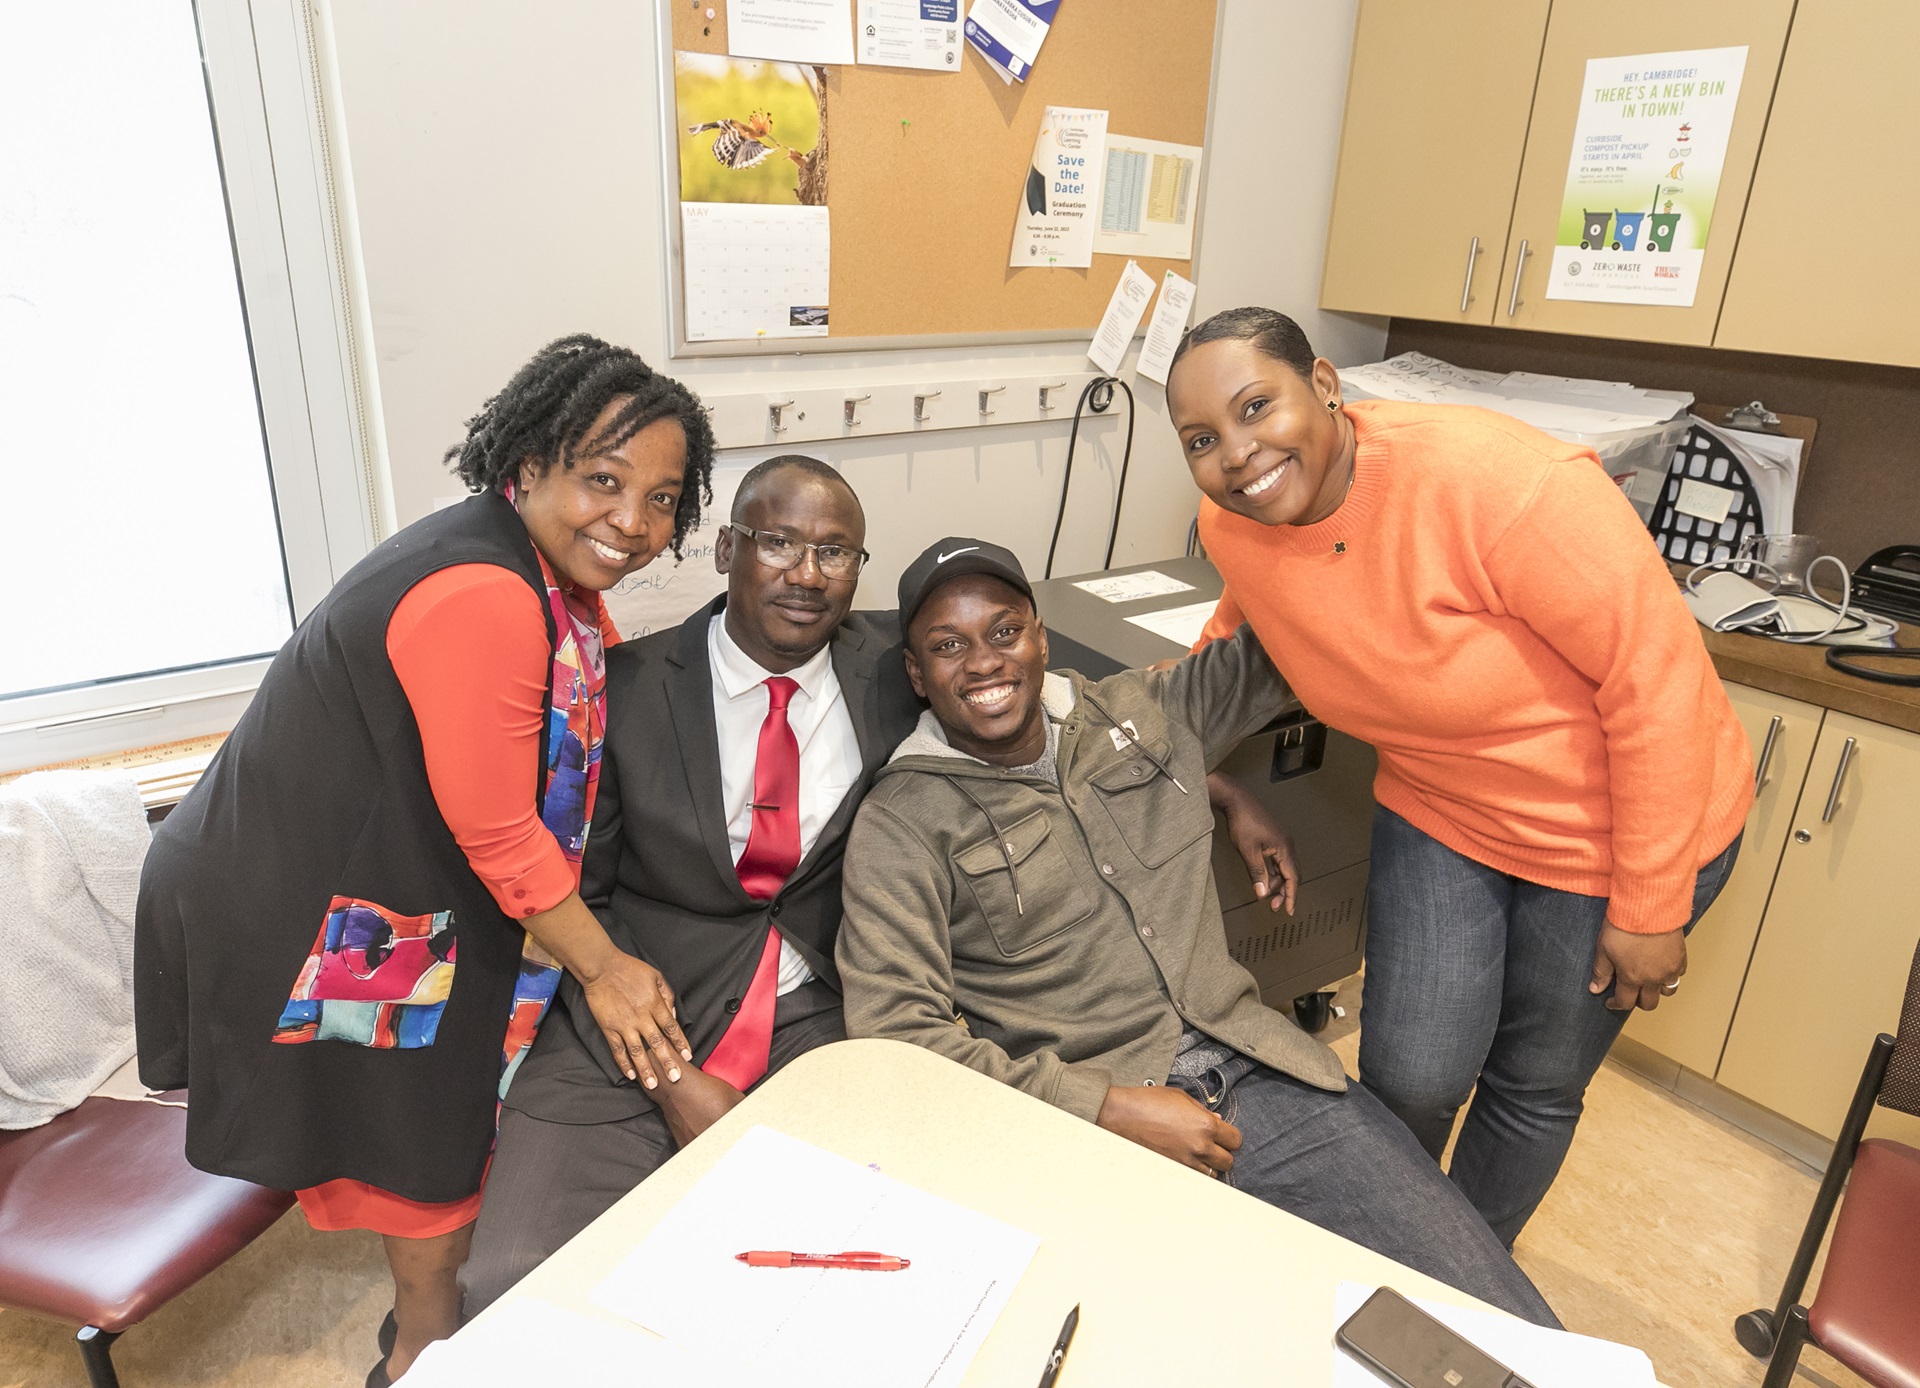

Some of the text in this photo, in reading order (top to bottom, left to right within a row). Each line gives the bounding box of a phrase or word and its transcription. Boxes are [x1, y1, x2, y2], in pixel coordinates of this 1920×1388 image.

[1623, 68, 1698, 83] HEY, CAMBRIDGE!
[1594, 81, 1726, 103] THERE'S A NEW BIN
[1622, 101, 1685, 118] IN TOWN!
[1586, 134, 1623, 143] CURBSIDE
[1584, 143, 1649, 152] COMPOST PICKUP
[1057, 154, 1085, 166] Save
[1583, 153, 1609, 161] STARTS
[1622, 152, 1643, 160] APRIL
[1060, 168, 1080, 180] the
[1054, 182, 1085, 194] Date!
[686, 207, 709, 217] MAY
[1052, 209, 1084, 219] Ceremony
[1617, 263, 1642, 272] WASTE
[1654, 271, 1679, 279] WORKS
[681, 544, 716, 558] Blanke
